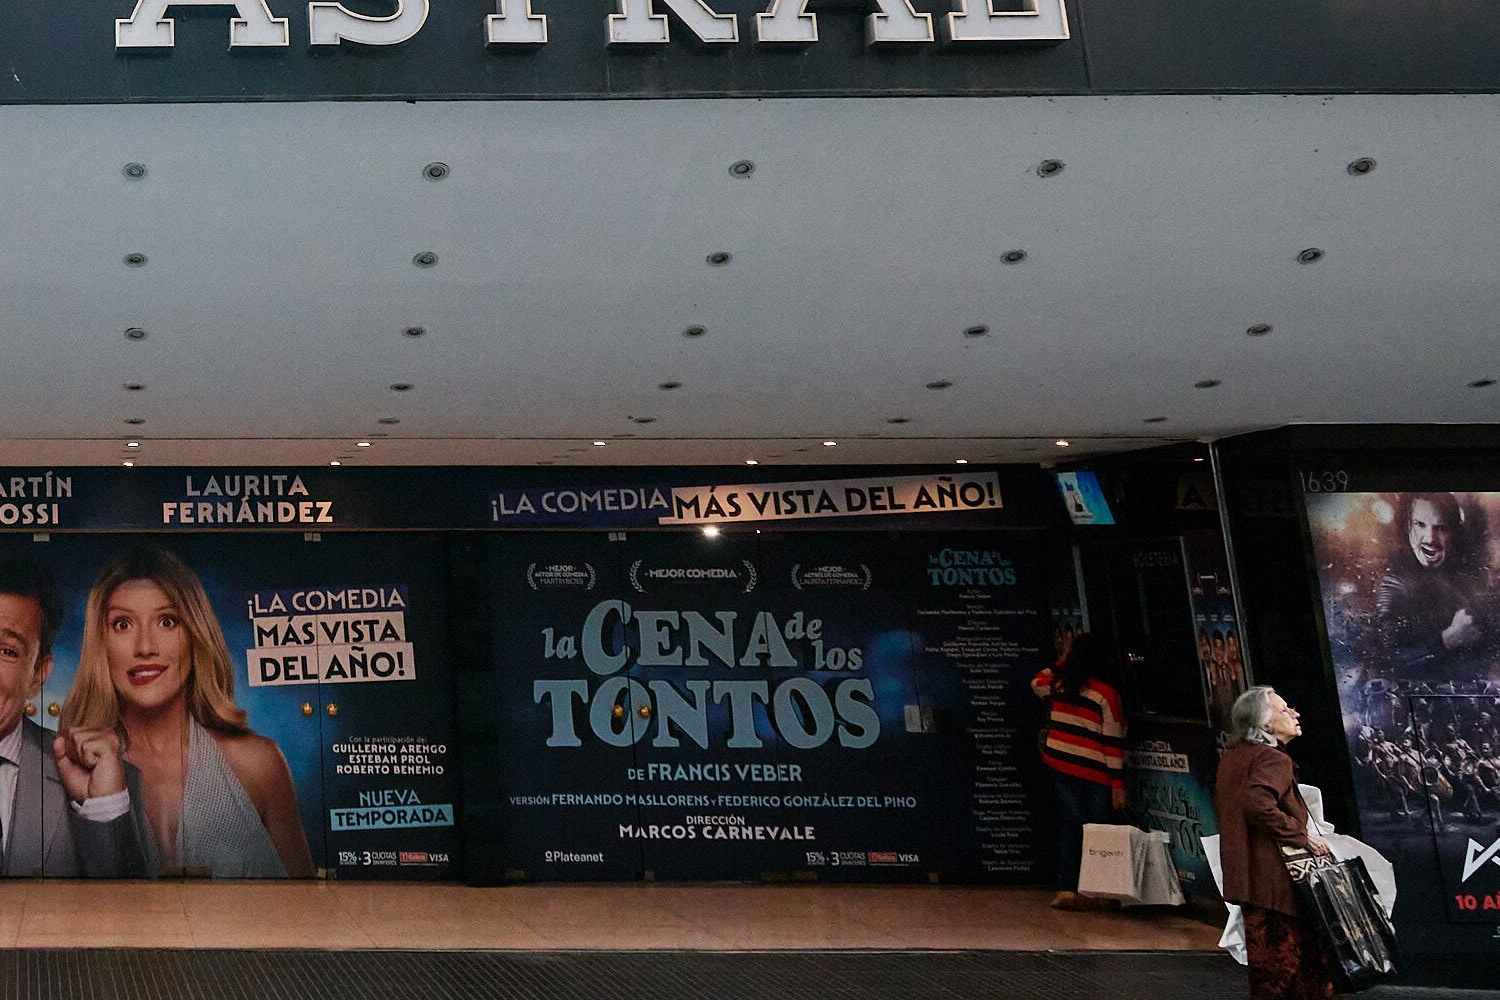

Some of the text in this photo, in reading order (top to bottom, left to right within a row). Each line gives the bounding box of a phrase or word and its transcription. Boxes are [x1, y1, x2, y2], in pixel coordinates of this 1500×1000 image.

[186, 475, 310, 497] LAURITA
[1299, 470, 1348, 492] 1639
[492, 478, 998, 522] ¡LA COMEDIA MÁS VISTA DEL AÑO!
[162, 496, 334, 524] FERNÁNDEZ
[939, 548, 994, 568] CENA
[649, 568, 737, 578] MEJOR COMEDIA
[927, 567, 1017, 586] TONTOS
[247, 588, 405, 620] ¡LA COMEDIA
[257, 616, 401, 646] MÁS VISTA
[542, 600, 822, 675] la CENA de
[260, 646, 405, 682] DEL AÑO!
[814, 639, 863, 671] los
[533, 677, 881, 750] TONTOS
[332, 744, 447, 754] GUILLERMO ARENGO
[371, 735, 416, 745] participación
[349, 754, 431, 764] ESTEBAN PROL
[336, 765, 444, 775] ROBERTO BENEMIO
[628, 764, 803, 782] DE FRANCIS VEBER
[359, 790, 421, 806] NUEVA
[510, 794, 550, 805] VERSIÓN
[552, 794, 623, 806] FERNANDO
[625, 795, 709, 806] MASLLORENS
[718, 795, 781, 807] FEDERICO
[784, 792, 854, 808] GONZÁLEZ
[857, 795, 881, 808] DEL
[884, 797, 917, 808] PINO
[335, 809, 448, 827] TEMPORADA
[686, 813, 745, 826] DIRECCIÓN
[619, 824, 816, 840] MARCOS CARNEVALE
[339, 851, 357, 862] 15%
[363, 851, 371, 866] 3
[371, 851, 397, 860] CUOTAS
[429, 854, 450, 862] VISA
[553, 851, 604, 864] Plateanet
[806, 851, 825, 862] 15%
[830, 851, 840, 866] 3
[899, 853, 919, 862] VISA
[1455, 891, 1500, 911] 10 A
